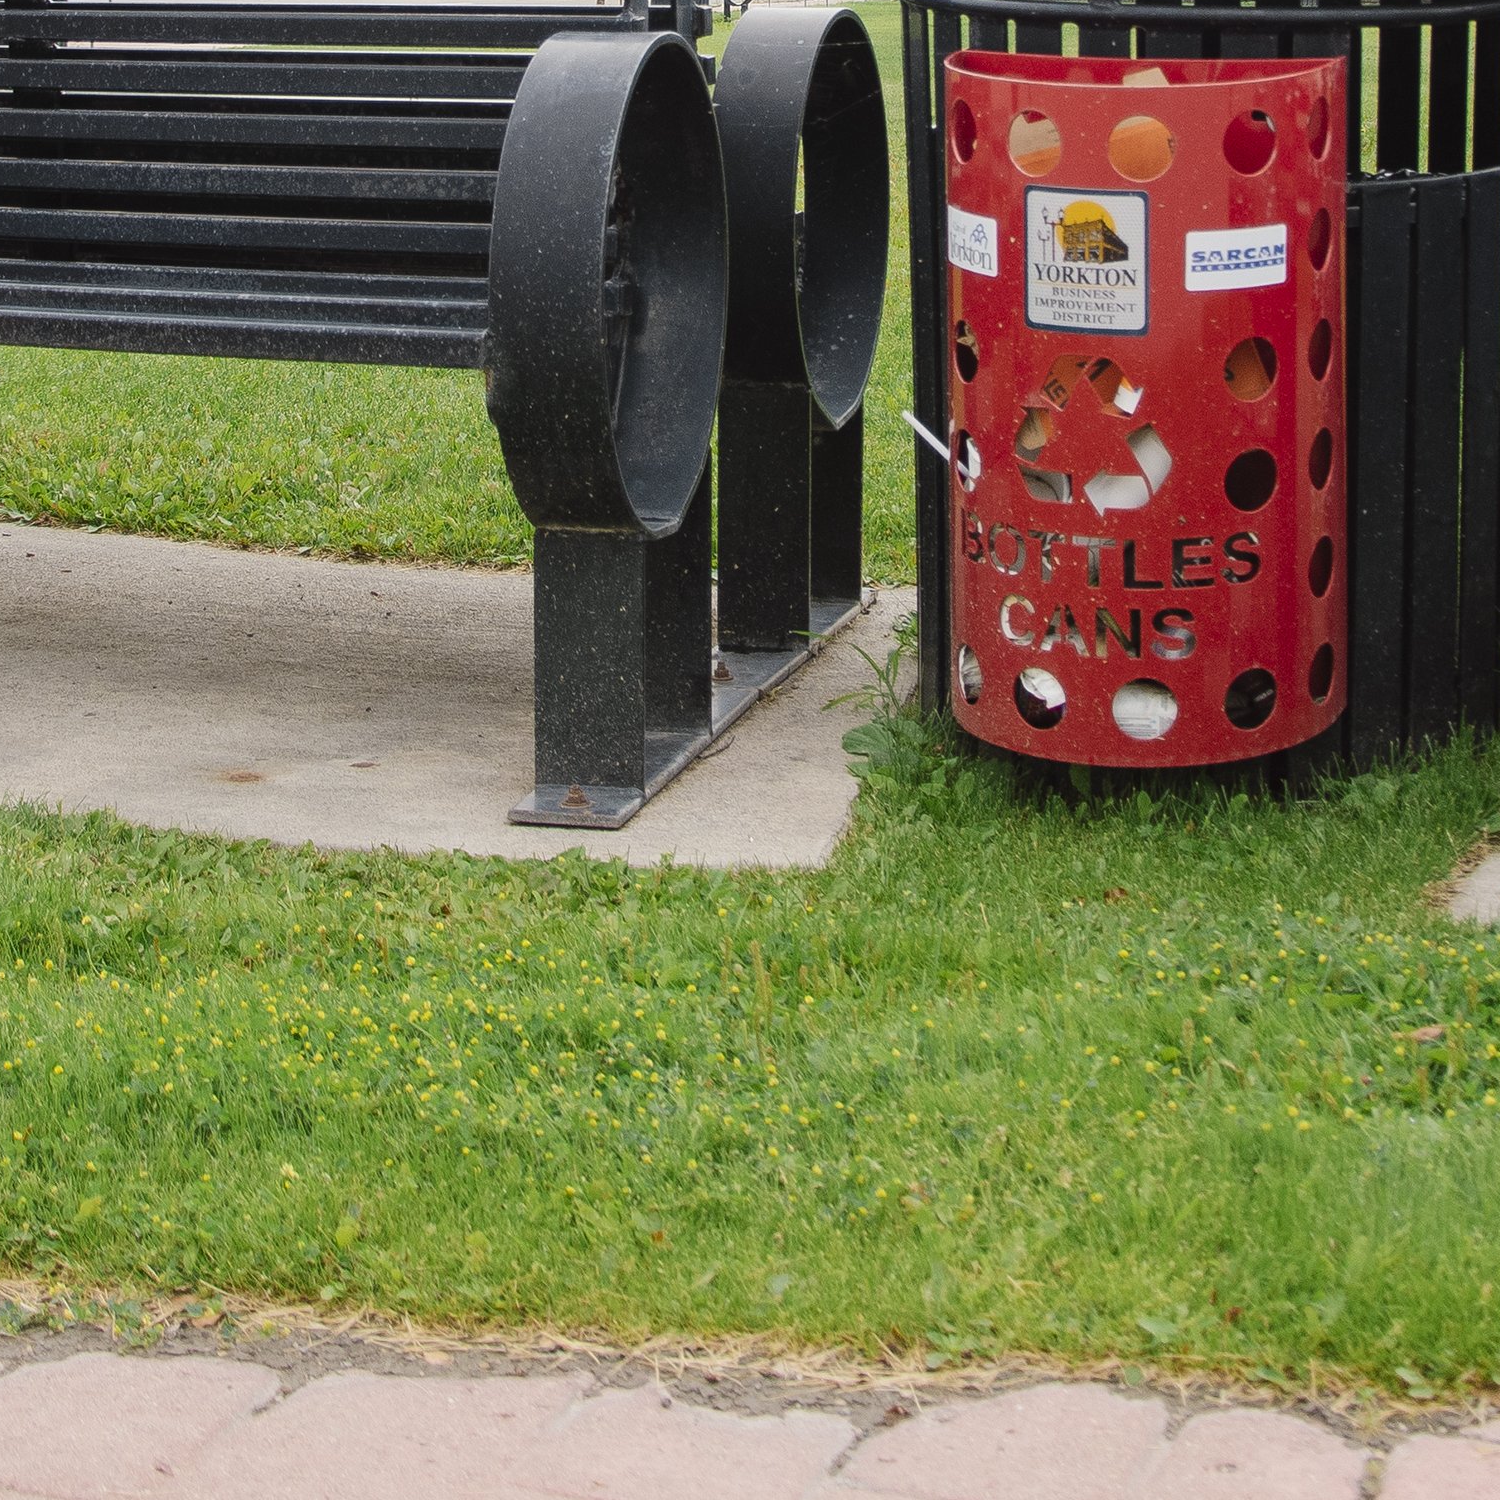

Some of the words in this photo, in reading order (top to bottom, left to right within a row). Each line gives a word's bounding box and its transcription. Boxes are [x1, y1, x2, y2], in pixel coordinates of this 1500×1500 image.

[1192, 243, 1285, 263] SARCAN
[1033, 263, 1138, 287] YORKTON
[1052, 287, 1116, 300] BUSINESS
[1035, 297, 1138, 313] IMPROVEMENT
[1052, 310, 1116, 325] DISTRICT
[961, 507, 1261, 590] BOTTLES
[1001, 593, 1197, 661] CANS
